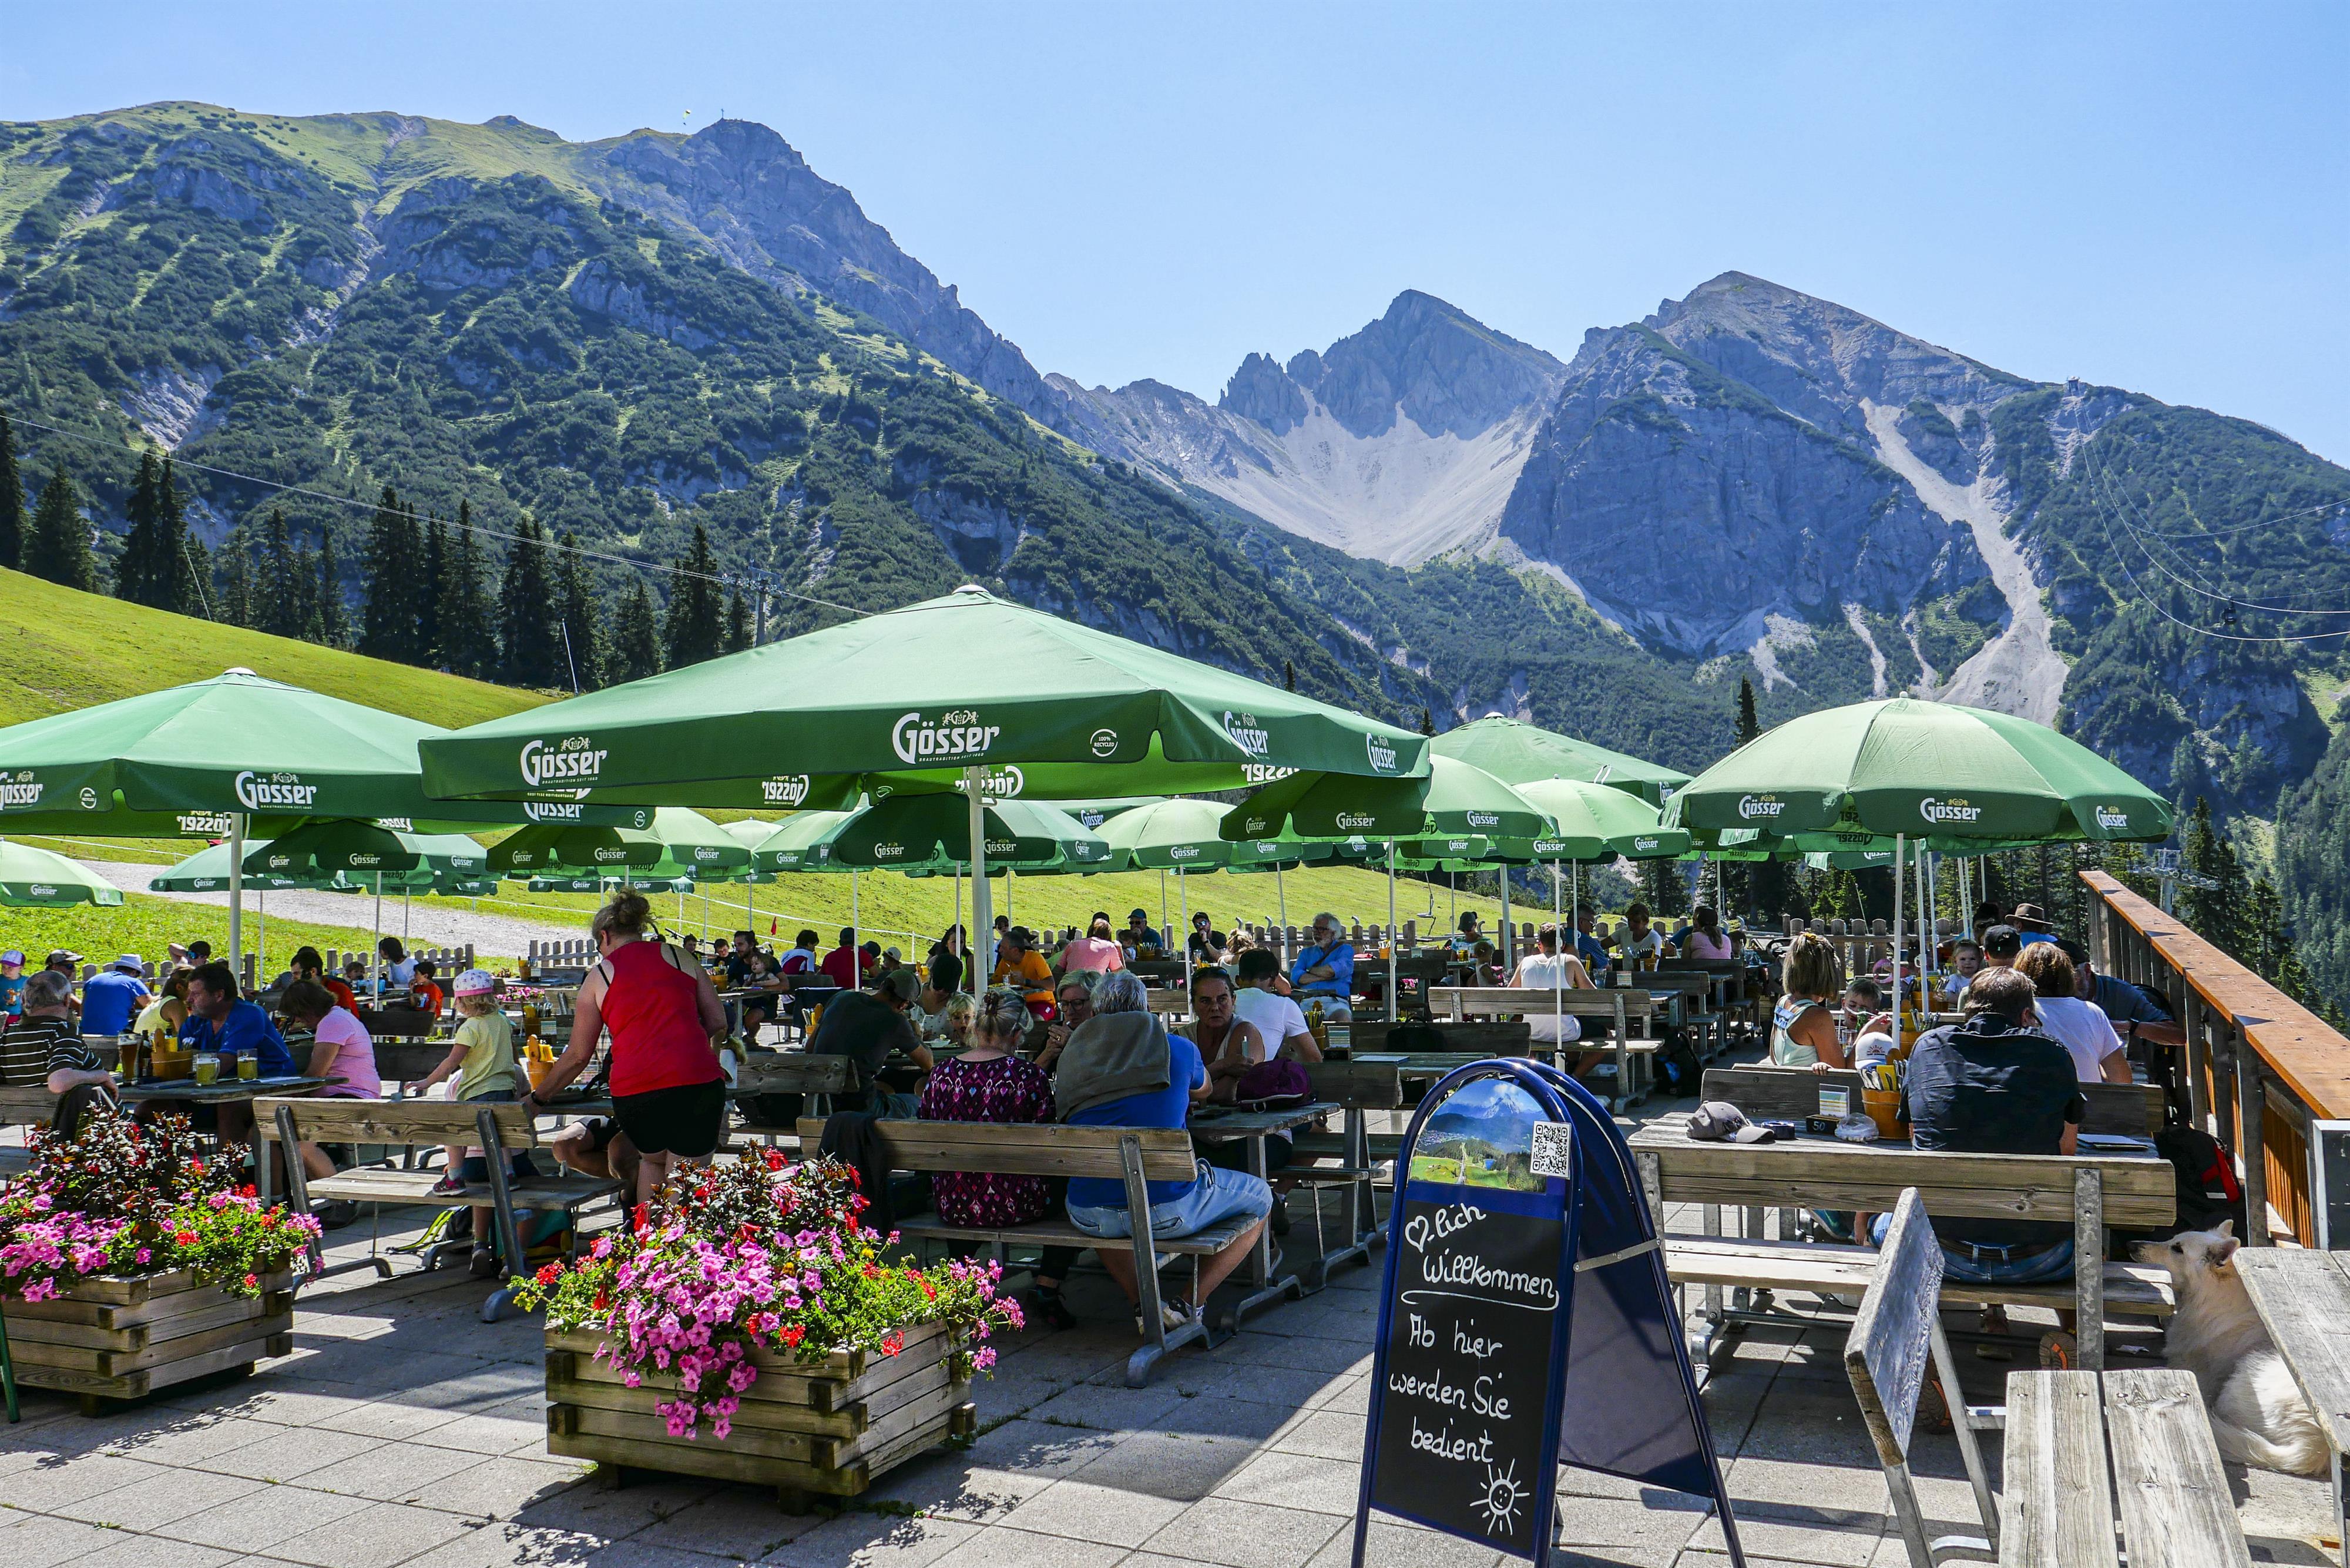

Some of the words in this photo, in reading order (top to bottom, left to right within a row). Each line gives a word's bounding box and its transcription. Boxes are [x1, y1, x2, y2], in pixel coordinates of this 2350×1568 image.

[892, 712, 999, 764] Gösser
[1224, 710, 1268, 758] Gösser
[1367, 732, 1396, 773] Gösser
[521, 740, 607, 786] Gösser
[236, 771, 317, 810] Gösser
[1738, 795, 1785, 820] Gösser
[1920, 797, 1981, 823] Gösser
[1081, 809, 1104, 828] Gösser
[1246, 817, 1265, 834] Gösser
[1336, 812, 1375, 830] Gösser
[1467, 810, 1499, 827] Gösser
[2096, 805, 2127, 830] Gösser
[875, 843, 904, 858] Gösser
[983, 838, 1016, 854] Gösser
[1449, 840, 1468, 851] Gösser
[1533, 840, 1566, 854] Gösser
[1634, 837, 1659, 851] Gösser
[350, 853, 381, 866] Gösser
[512, 850, 532, 864] Gösser
[595, 847, 626, 861] Gösser
[694, 847, 719, 861] Gösser
[776, 852, 798, 864] Gösser
[1170, 847, 1200, 859] Gösser
[270, 855, 290, 868] Gösser
[451, 855, 473, 868] Gösser
[31, 884, 58, 896] Gösser
[194, 878, 216, 888] Gösser
[1812, 1120, 1826, 1131] 50
[1424, 1248, 1555, 1298] Willkommen
[1409, 1312, 1435, 1348] Ab
[1454, 1318, 1503, 1358] hier
[1389, 1368, 1467, 1410] werden
[1471, 1372, 1512, 1420] Sie
[1411, 1415, 1493, 1463] bedient
